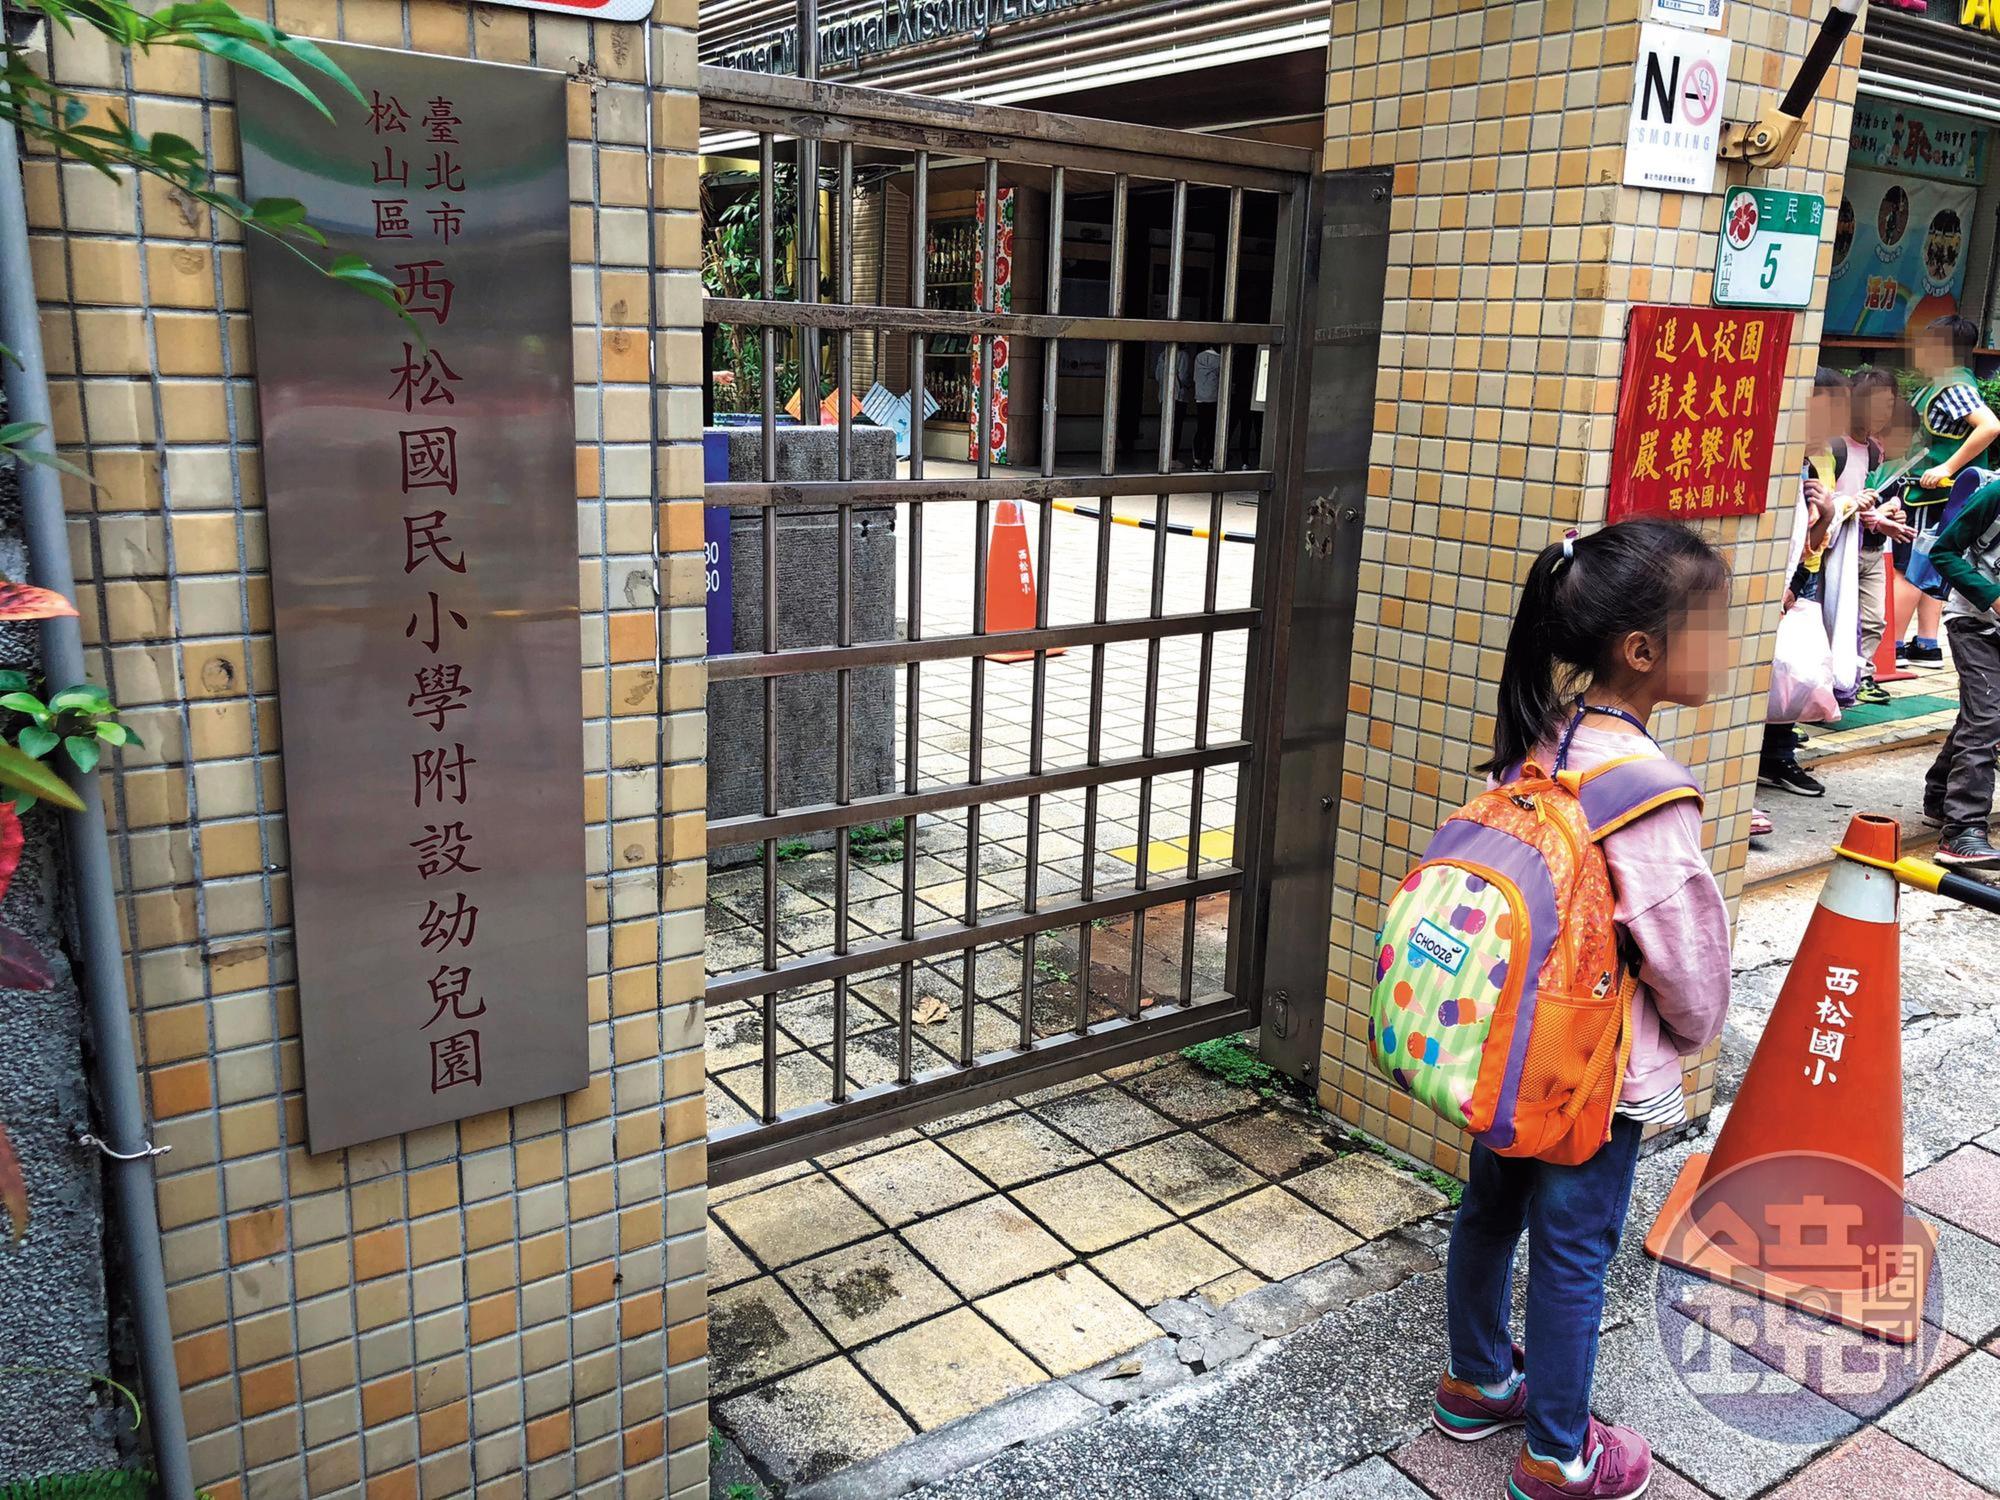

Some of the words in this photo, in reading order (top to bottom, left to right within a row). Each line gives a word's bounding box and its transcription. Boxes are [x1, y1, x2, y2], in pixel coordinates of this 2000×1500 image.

[782, 0, 889, 73] Mnicipal
[1638, 127, 1710, 150] SMOKING
[365, 89, 413, 240] 松山區
[421, 96, 467, 245] 臺北市
[1761, 197, 1822, 225] 三民路
[1720, 252, 1733, 297] 松山區
[1760, 243, 1782, 290] 5
[1865, 274, 1898, 311] 活力
[1655, 317, 1764, 364] 進入校園
[1647, 371, 1756, 422] 請走大門
[1631, 426, 1754, 482] 嚴禁攀爬
[388, 260, 487, 1094] 西松國民小學附設幼兒園
[1803, 965, 1860, 1087] 西松國小
